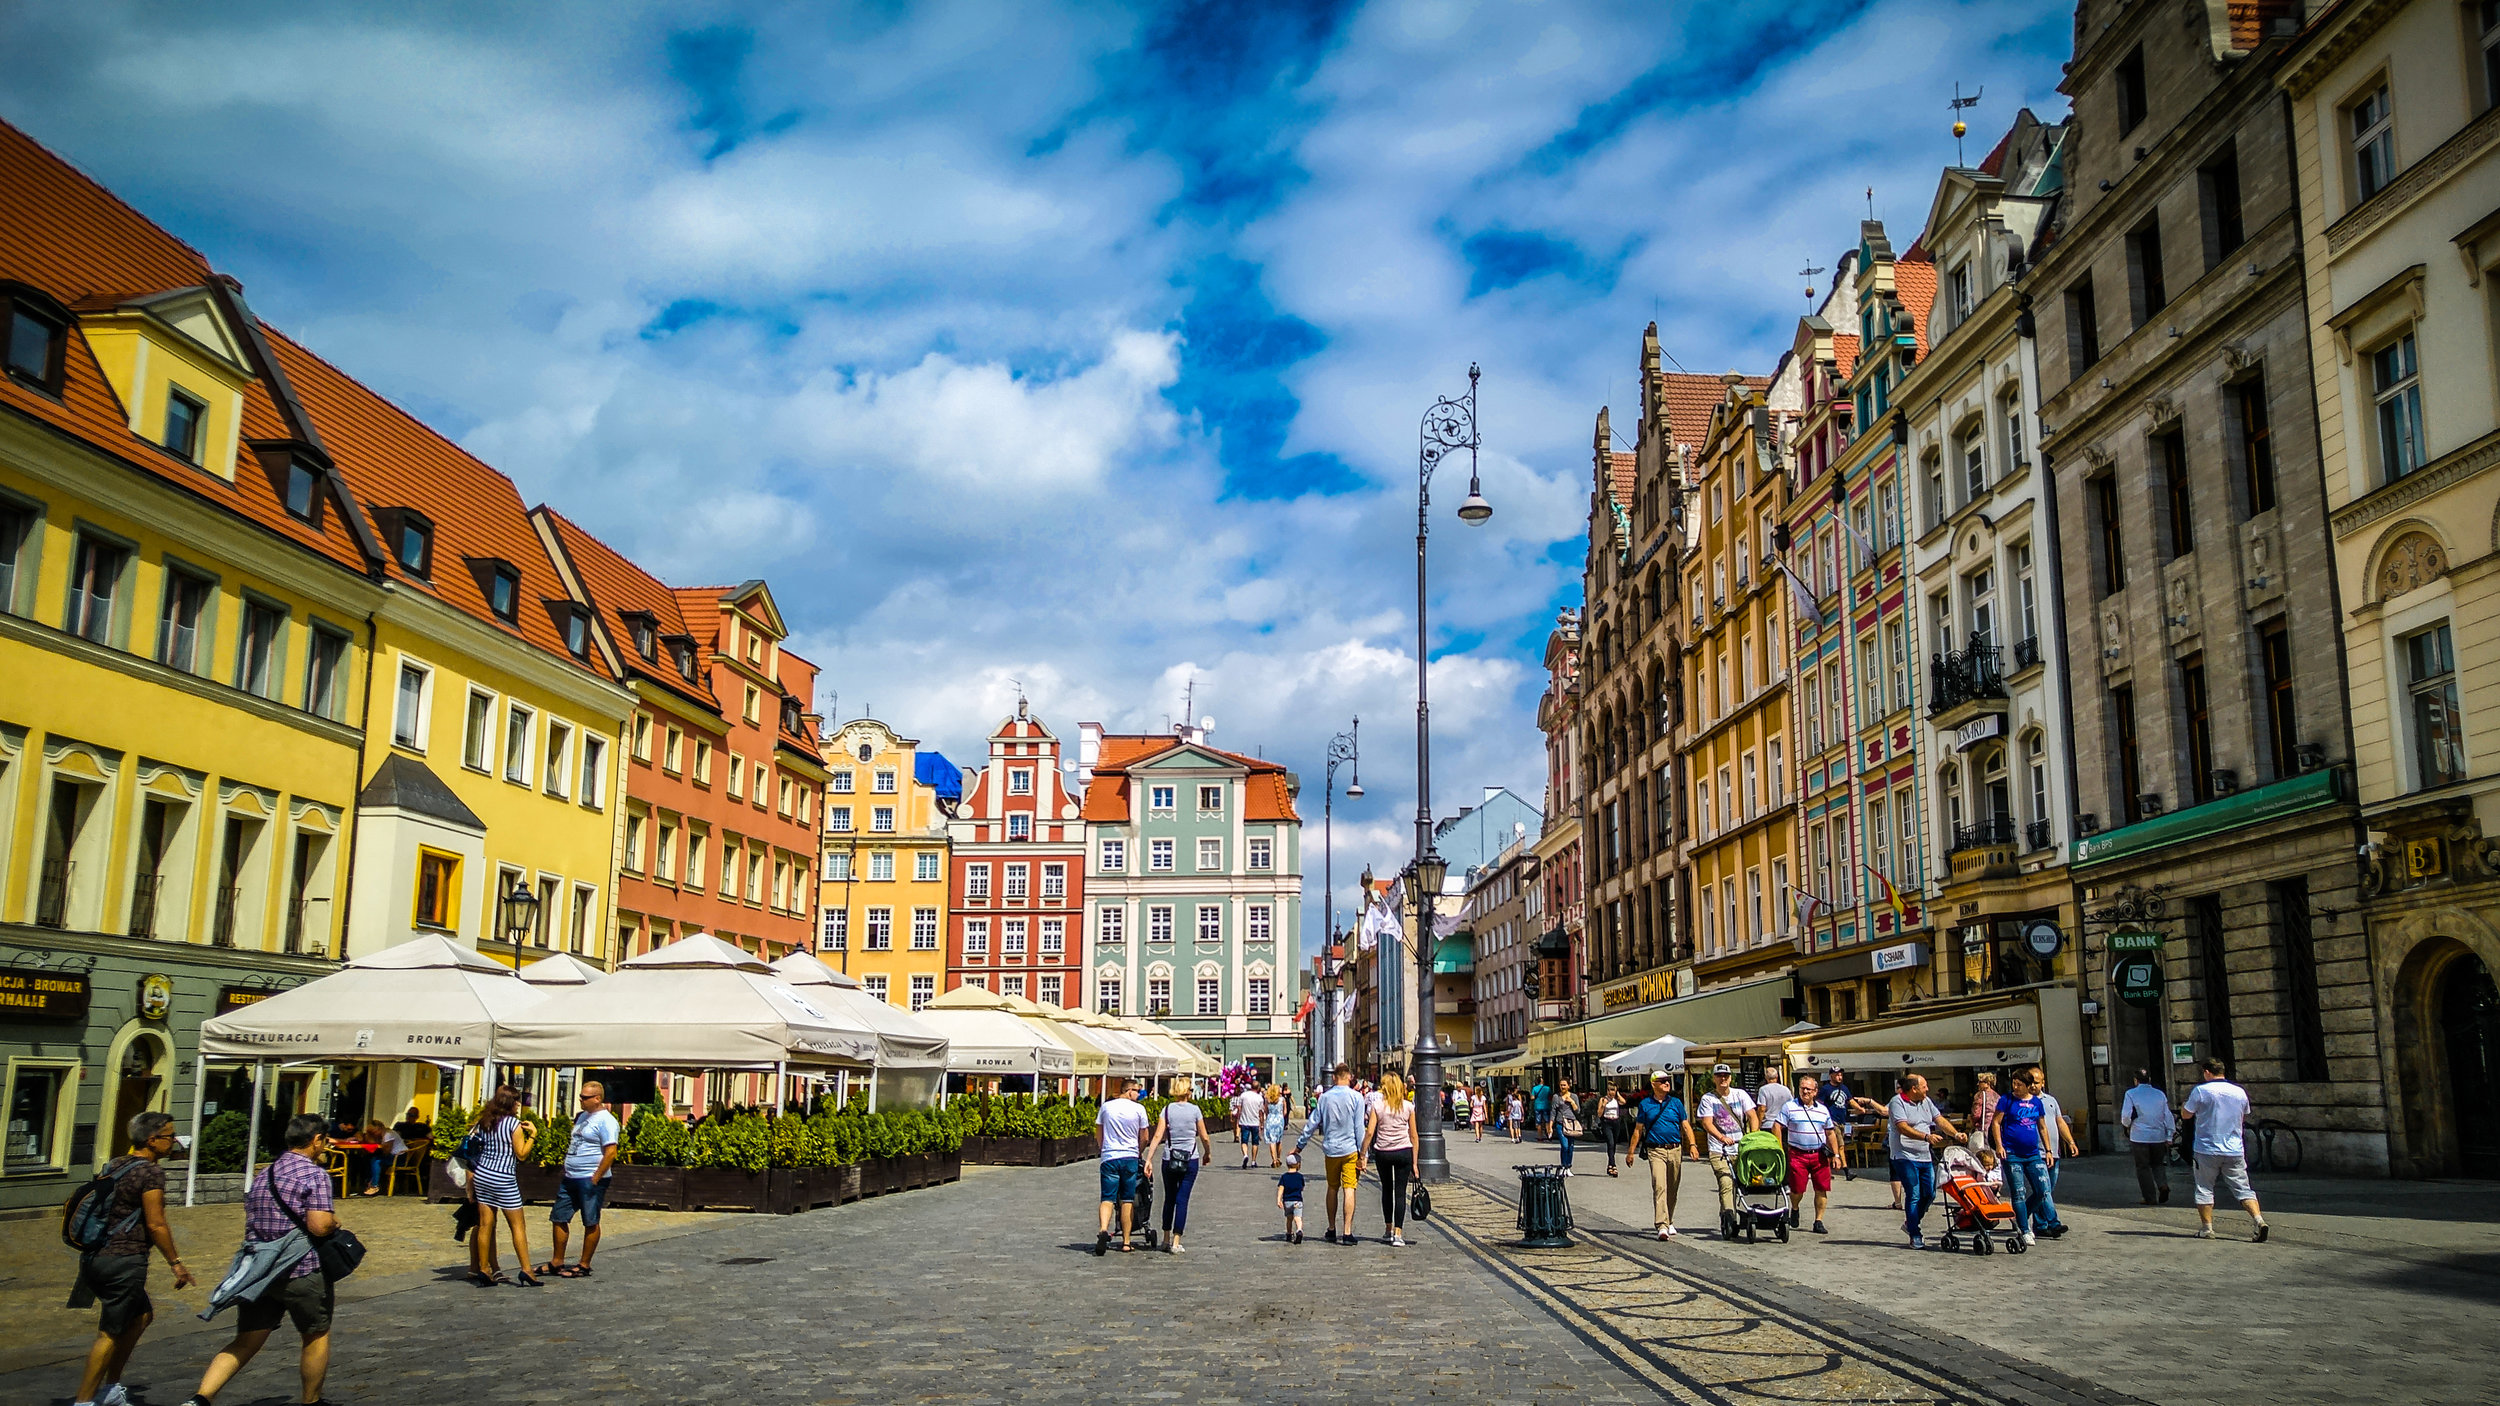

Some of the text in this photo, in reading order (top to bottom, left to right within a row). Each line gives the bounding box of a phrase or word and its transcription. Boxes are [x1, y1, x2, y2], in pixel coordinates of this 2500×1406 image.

[2101, 838, 2113, 850] BPS
[2114, 936, 2158, 948] BANK
[1883, 949, 1906, 963] CSHARK
[34, 978, 83, 993] BROWAR
[1640, 970, 1674, 1003] SPHINX
[2123, 989, 2159, 999] Bank BPS
[1971, 1019, 2021, 1034] BERNARD
[225, 1033, 462, 1045] RESTAURACJA BROWAR
